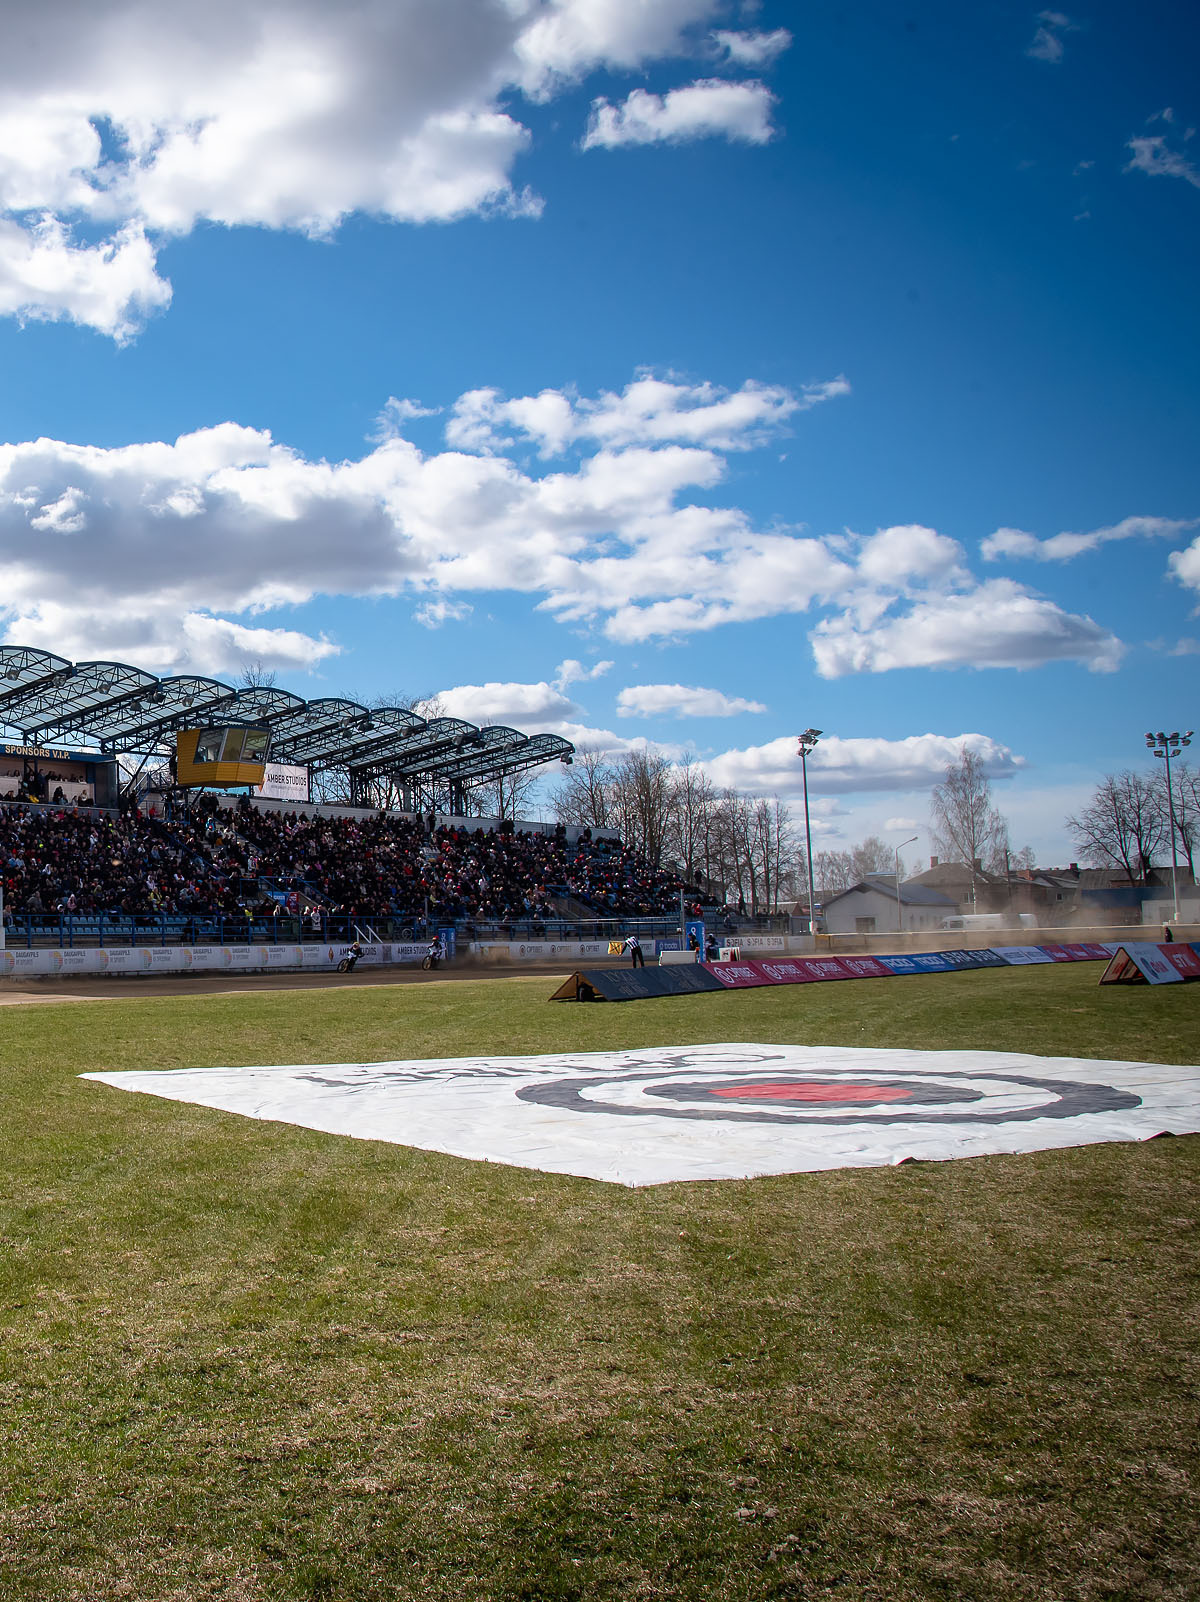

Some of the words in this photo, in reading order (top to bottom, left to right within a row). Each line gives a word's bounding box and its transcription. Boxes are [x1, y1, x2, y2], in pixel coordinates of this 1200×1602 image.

[5, 745, 50, 758] SPONSORS
[52, 750, 71, 760] V.I.P.
[267, 773, 286, 784] AMBER
[286, 775, 307, 787] STUDIOS
[397, 946, 413, 954] AMBER
